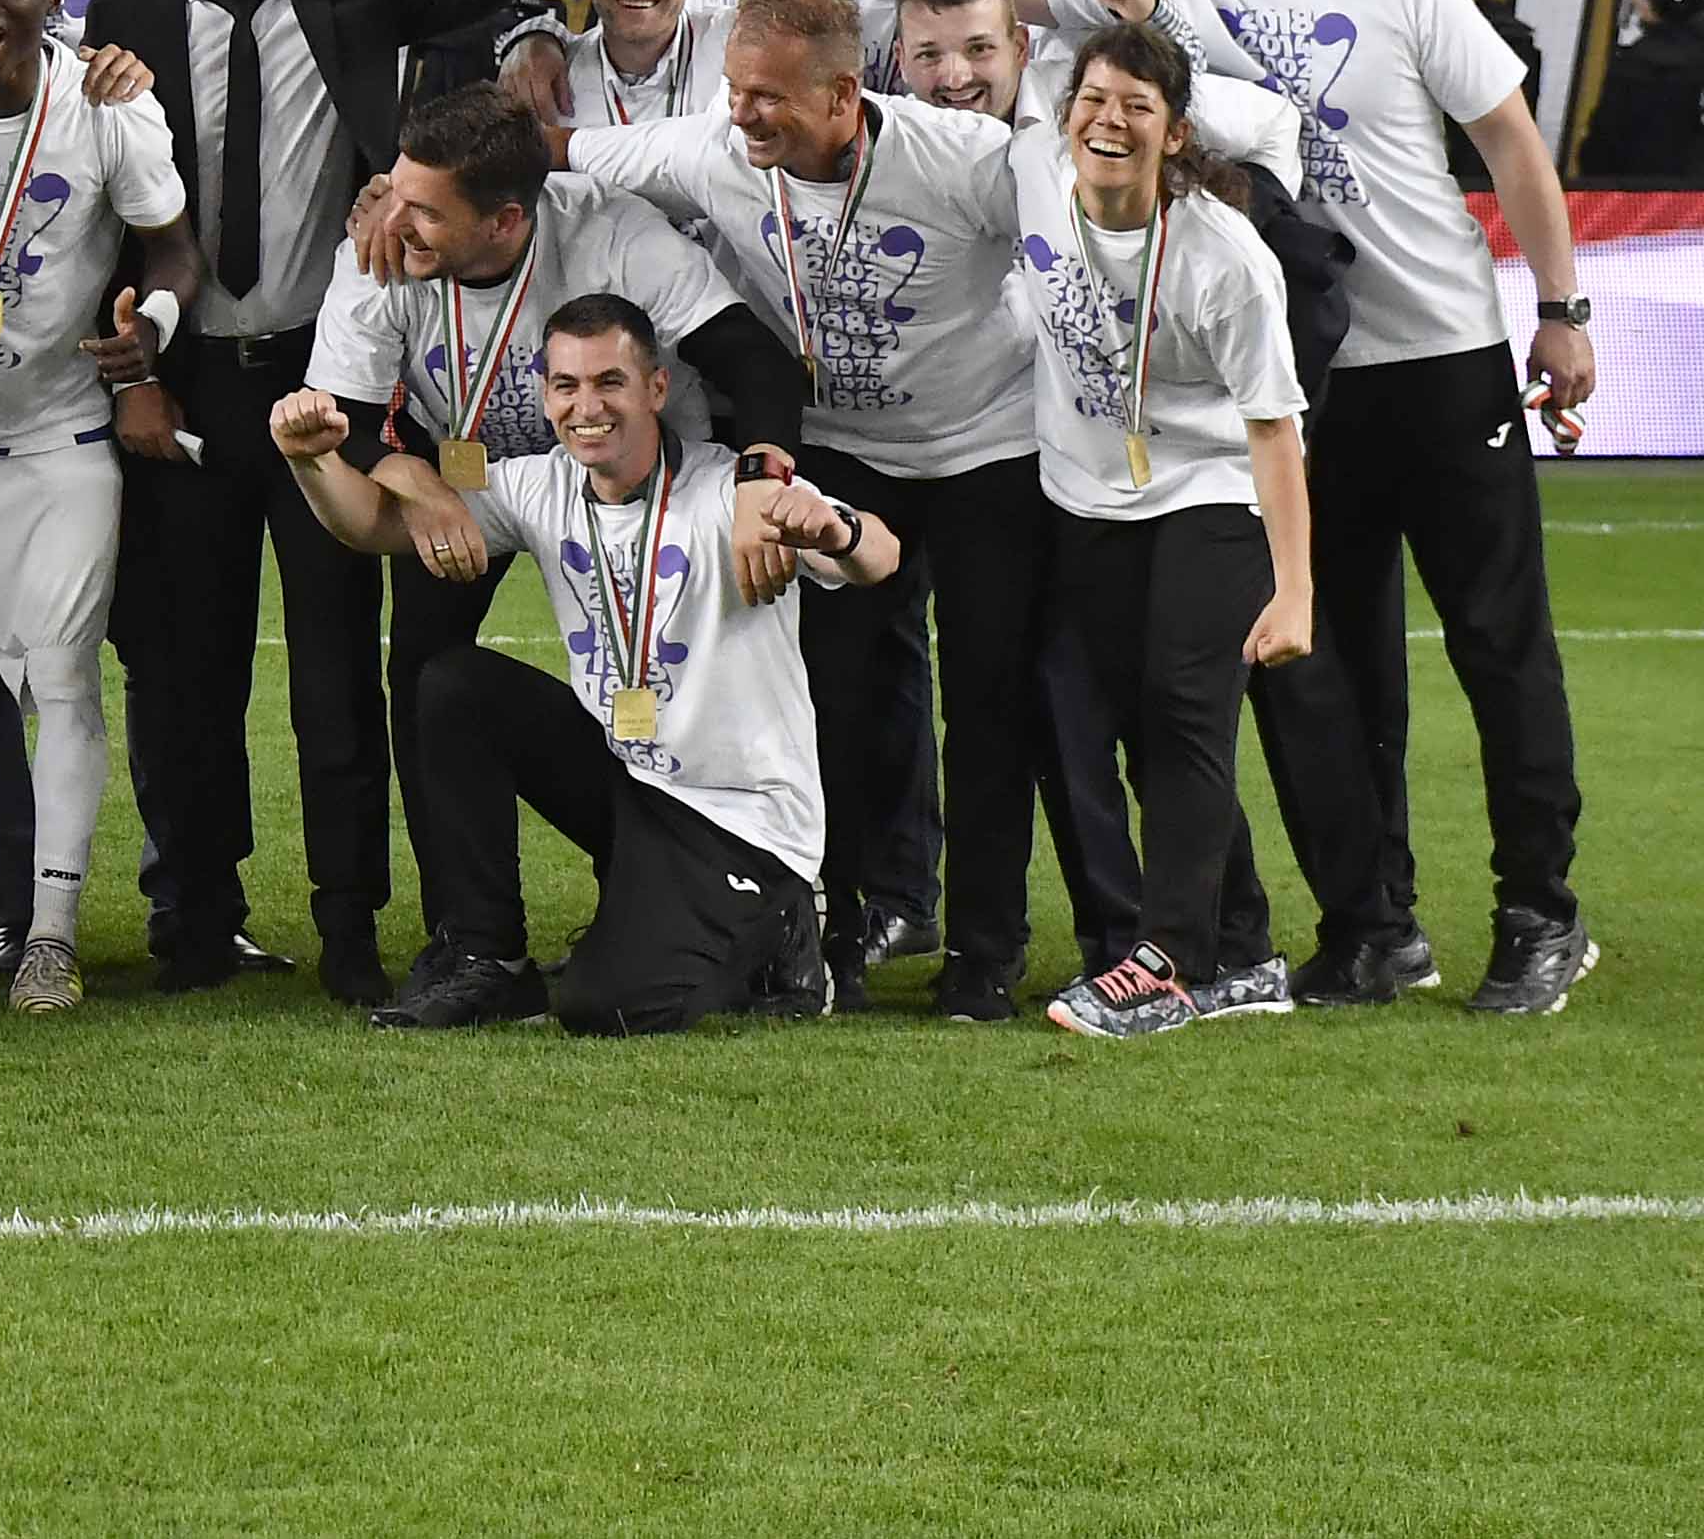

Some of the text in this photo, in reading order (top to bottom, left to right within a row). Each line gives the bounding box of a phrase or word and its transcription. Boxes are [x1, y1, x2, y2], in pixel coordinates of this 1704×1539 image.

[1240, 8, 1315, 36] 2018
[1303, 175, 1363, 203] 969
[832, 357, 883, 375] 1975
[833, 375, 883, 390] 1970
